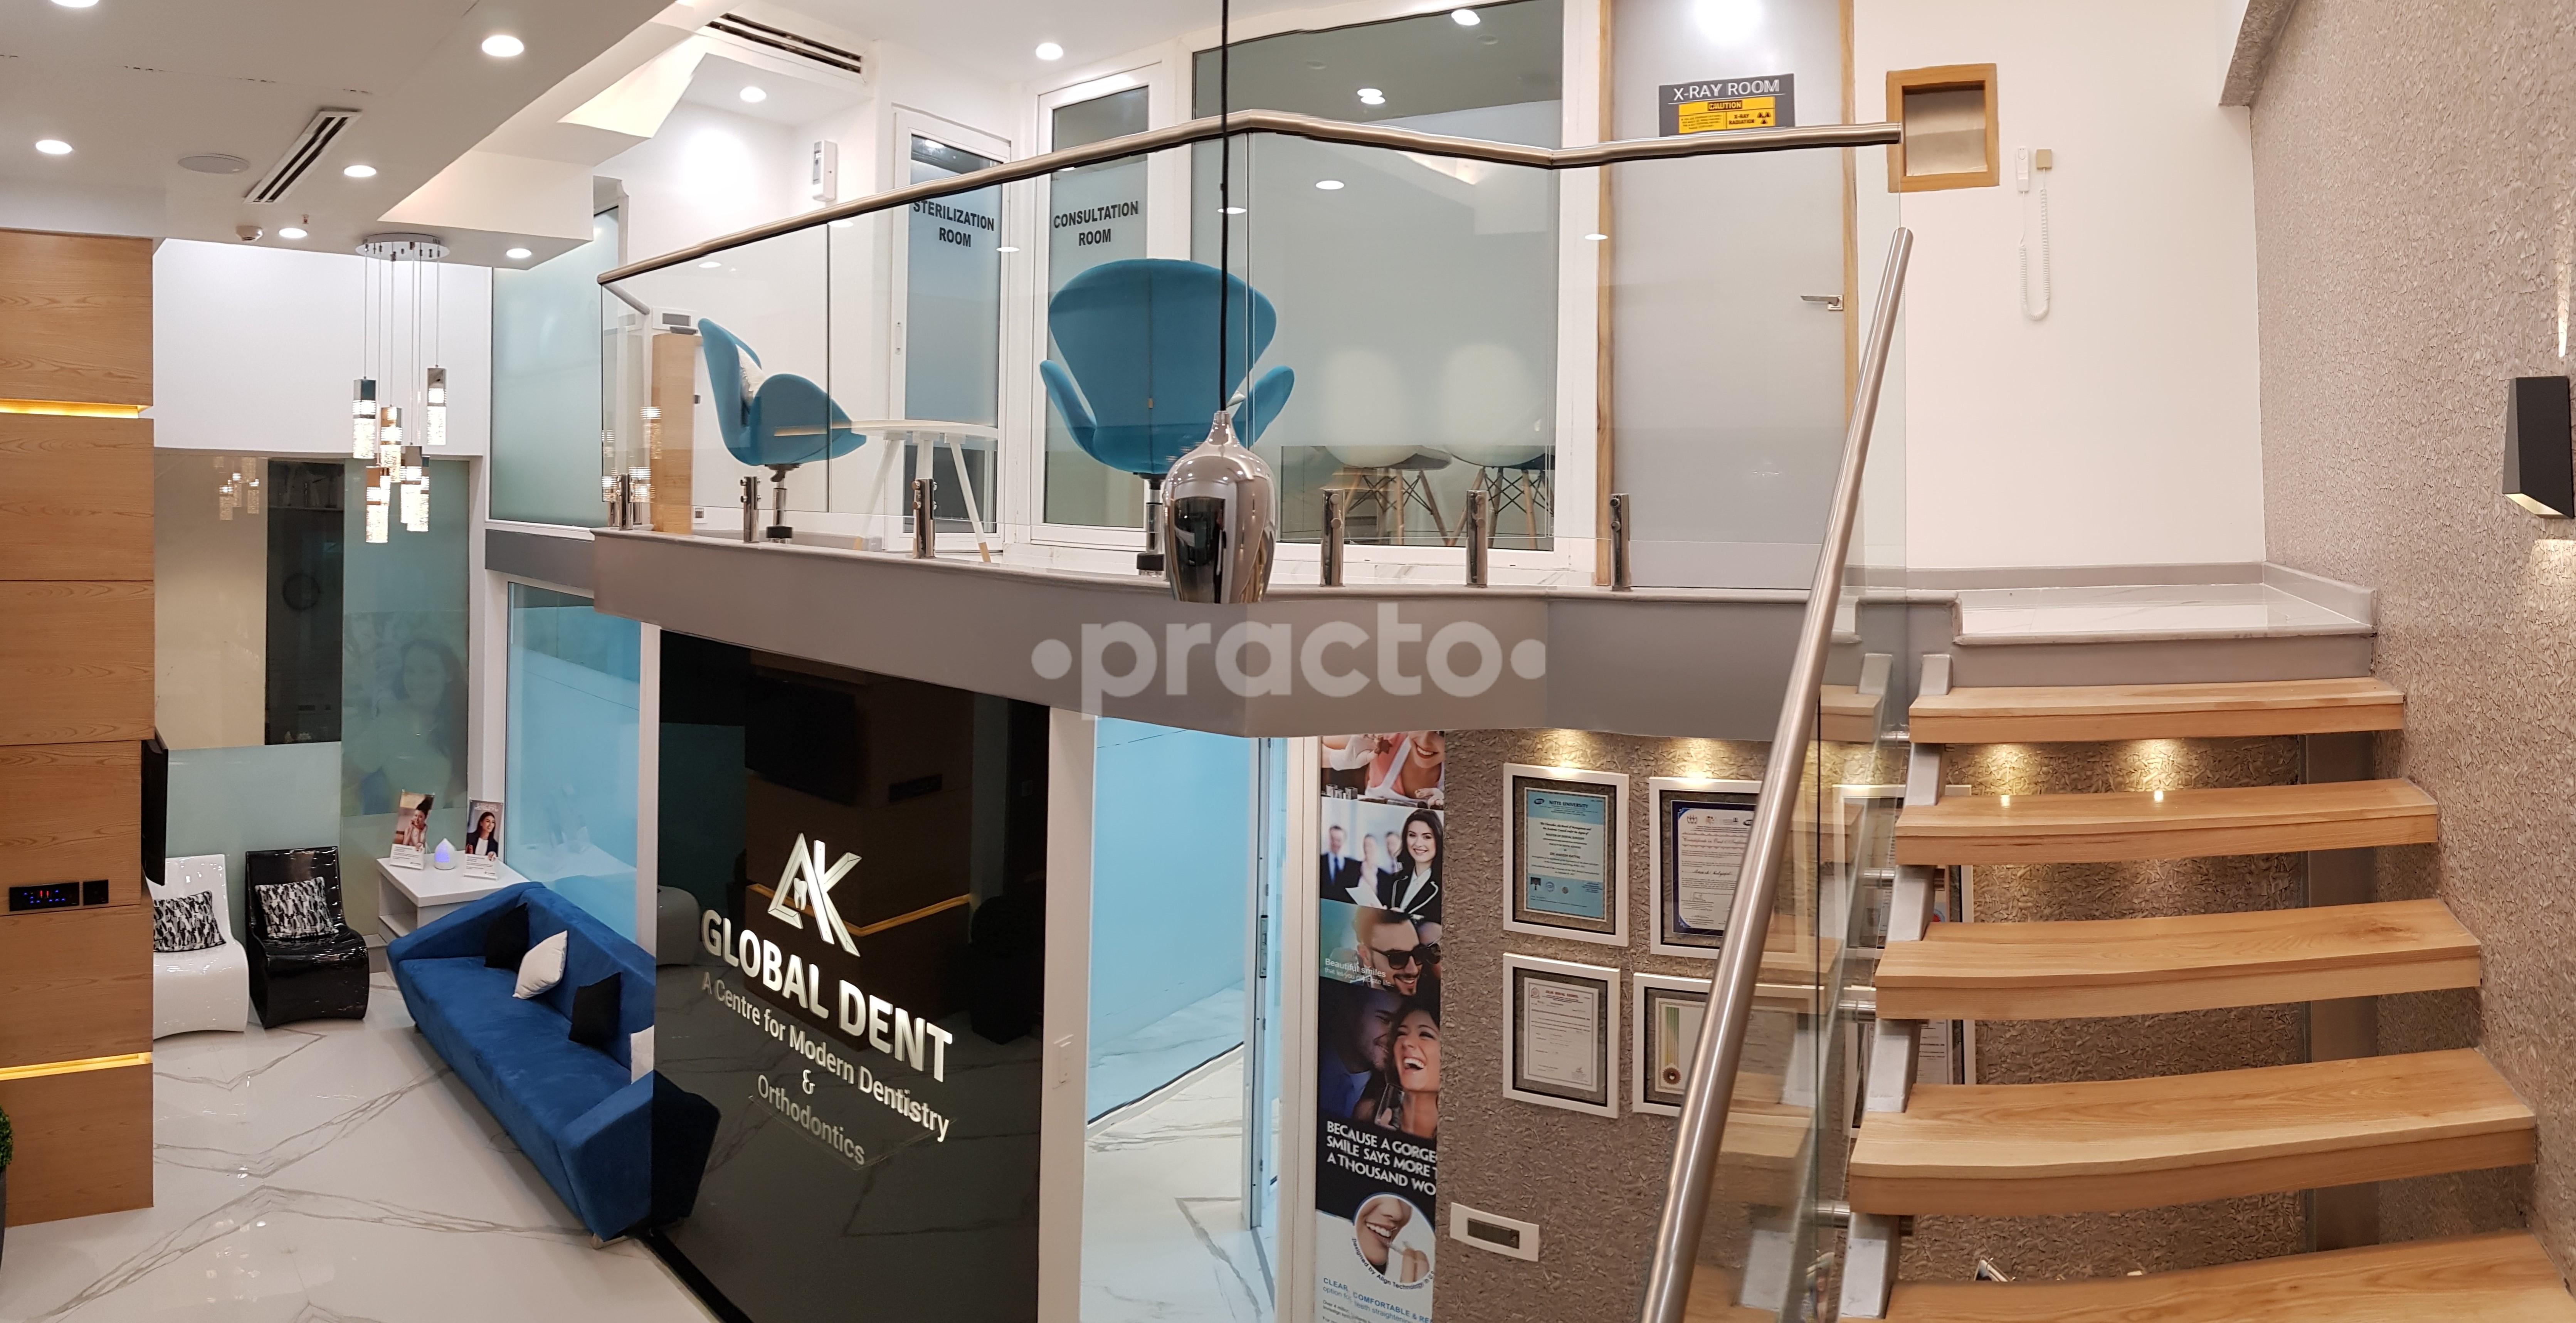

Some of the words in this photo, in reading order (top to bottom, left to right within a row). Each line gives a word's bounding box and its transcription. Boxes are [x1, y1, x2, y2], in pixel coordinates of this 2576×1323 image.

[1673, 83, 1722, 101] X-RAY
[1728, 79, 1779, 95] ROOM
[1708, 102, 1741, 110] CAUTION
[913, 200, 994, 231] STERILIZATION
[1053, 200, 1138, 229] CONSULTATION
[939, 227, 971, 247] ROOM
[1078, 229, 1111, 246] ROOM
[1325, 958, 1359, 972] Beautiful
[1361, 968, 1386, 978] smiles
[701, 909, 829, 1019] GLOBAL
[838, 979, 955, 1083] DENT
[701, 972, 713, 995] A
[714, 978, 761, 1025] Centre
[763, 1008, 786, 1041] for
[789, 1020, 855, 1086] Modern
[858, 1066, 950, 1142] Dentistry
[802, 1069, 815, 1094] &
[757, 1074, 865, 1166] Orthodontics
[1327, 1121, 1377, 1147] BECAUSE
[1380, 1138, 1391, 1150] A
[1392, 1141, 1437, 1163] GORGE
[1327, 1135, 1359, 1157] SMILE
[1364, 1148, 1390, 1165] SAYS
[1393, 1157, 1431, 1177] MORE
[1327, 1152, 1336, 1164] A
[1337, 1154, 1408, 1187] THOUSAND
[1411, 1178, 1436, 1195] WO
[1352, 1237, 1369, 1267] Designed
[1368, 1267, 1376, 1275] by
[1376, 1274, 1391, 1285] Align
[1323, 1286, 1342, 1297] option
[1354, 1301, 1370, 1311] teeth
[1353, 1292, 1409, 1317] COMFORTABLE
